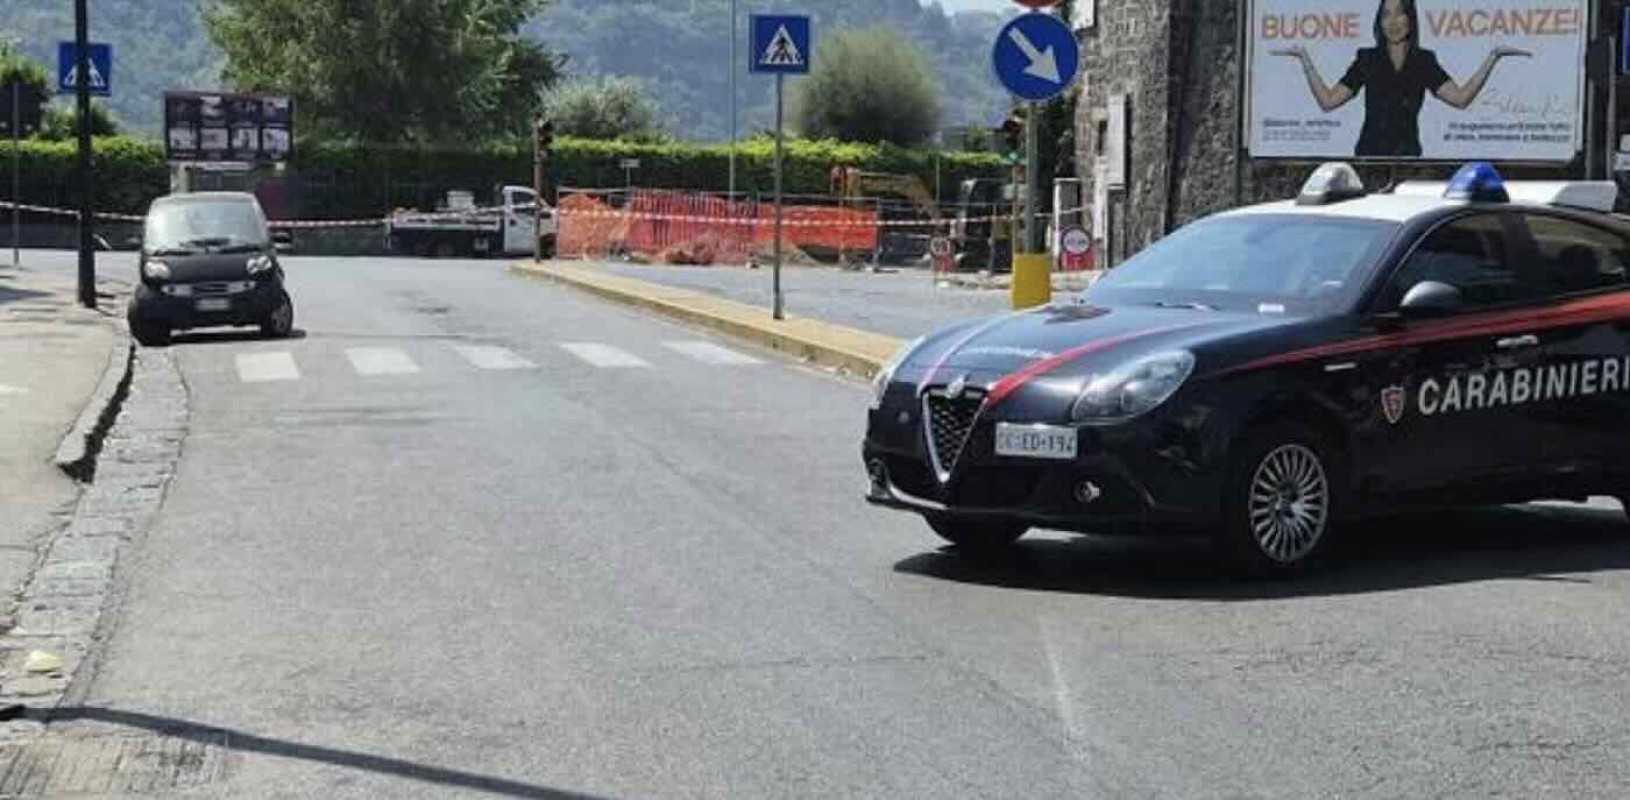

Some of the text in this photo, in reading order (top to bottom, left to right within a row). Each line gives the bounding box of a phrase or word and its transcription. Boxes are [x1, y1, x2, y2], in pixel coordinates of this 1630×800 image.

[1261, 8, 1580, 39] BUONE VACANZE!
[1418, 354, 1630, 416] CARABINIERI
